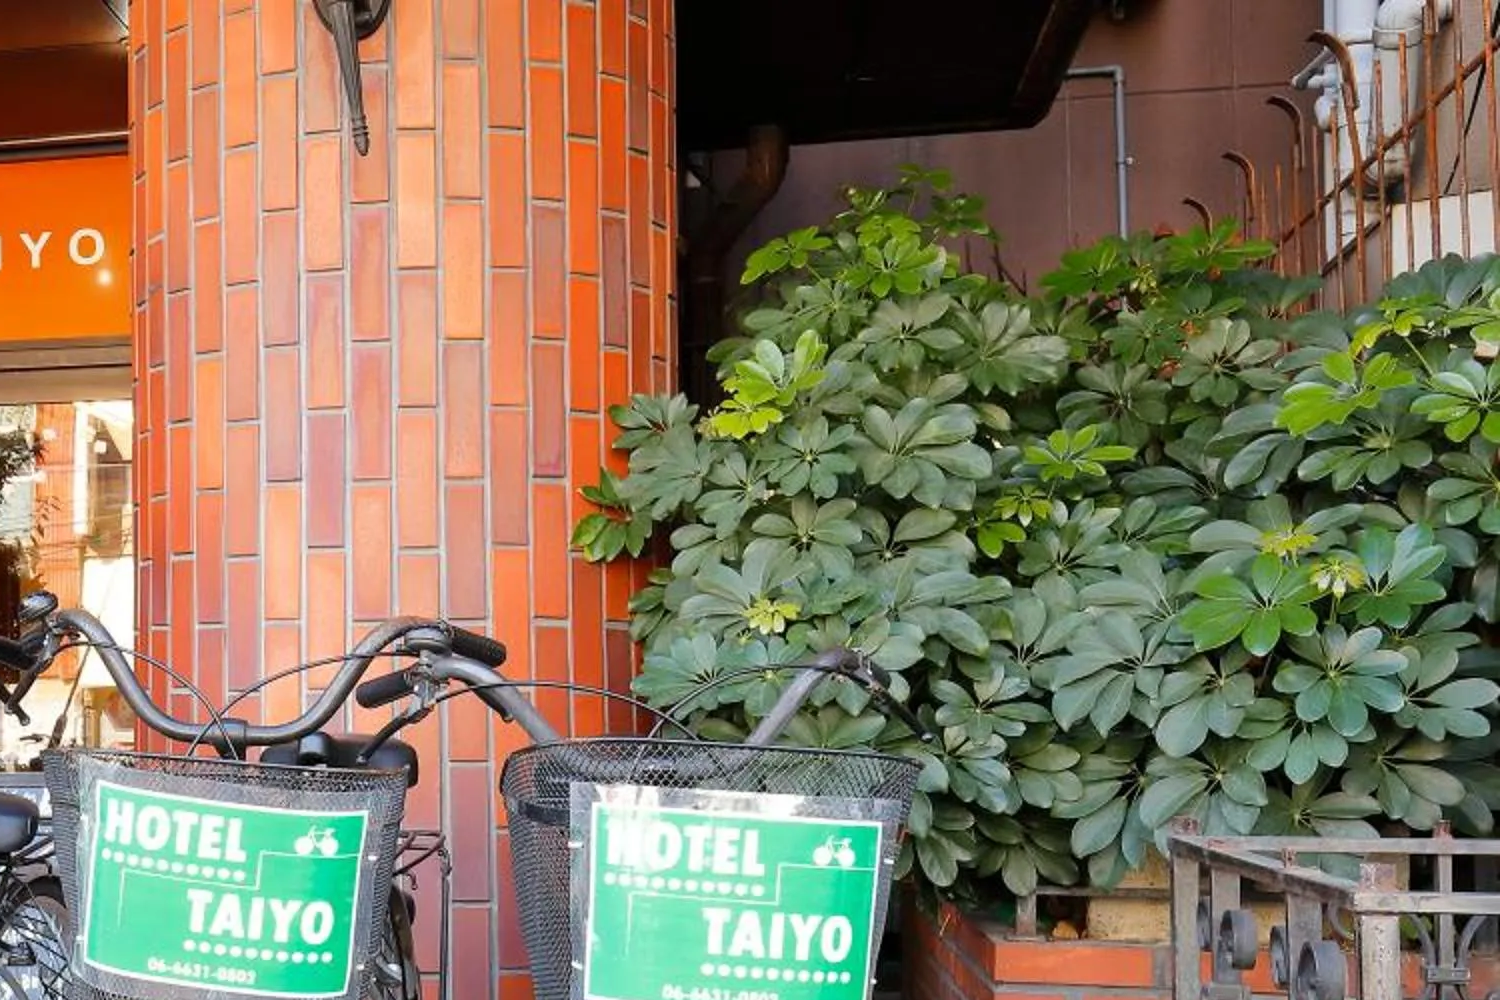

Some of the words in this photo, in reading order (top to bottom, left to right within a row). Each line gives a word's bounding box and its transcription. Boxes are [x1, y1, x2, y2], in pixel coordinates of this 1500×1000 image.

[103, 798, 247, 863] HOTEL
[605, 817, 765, 877] HOTEL
[187, 888, 334, 945] TAIYO
[702, 907, 851, 963] TAIYO
